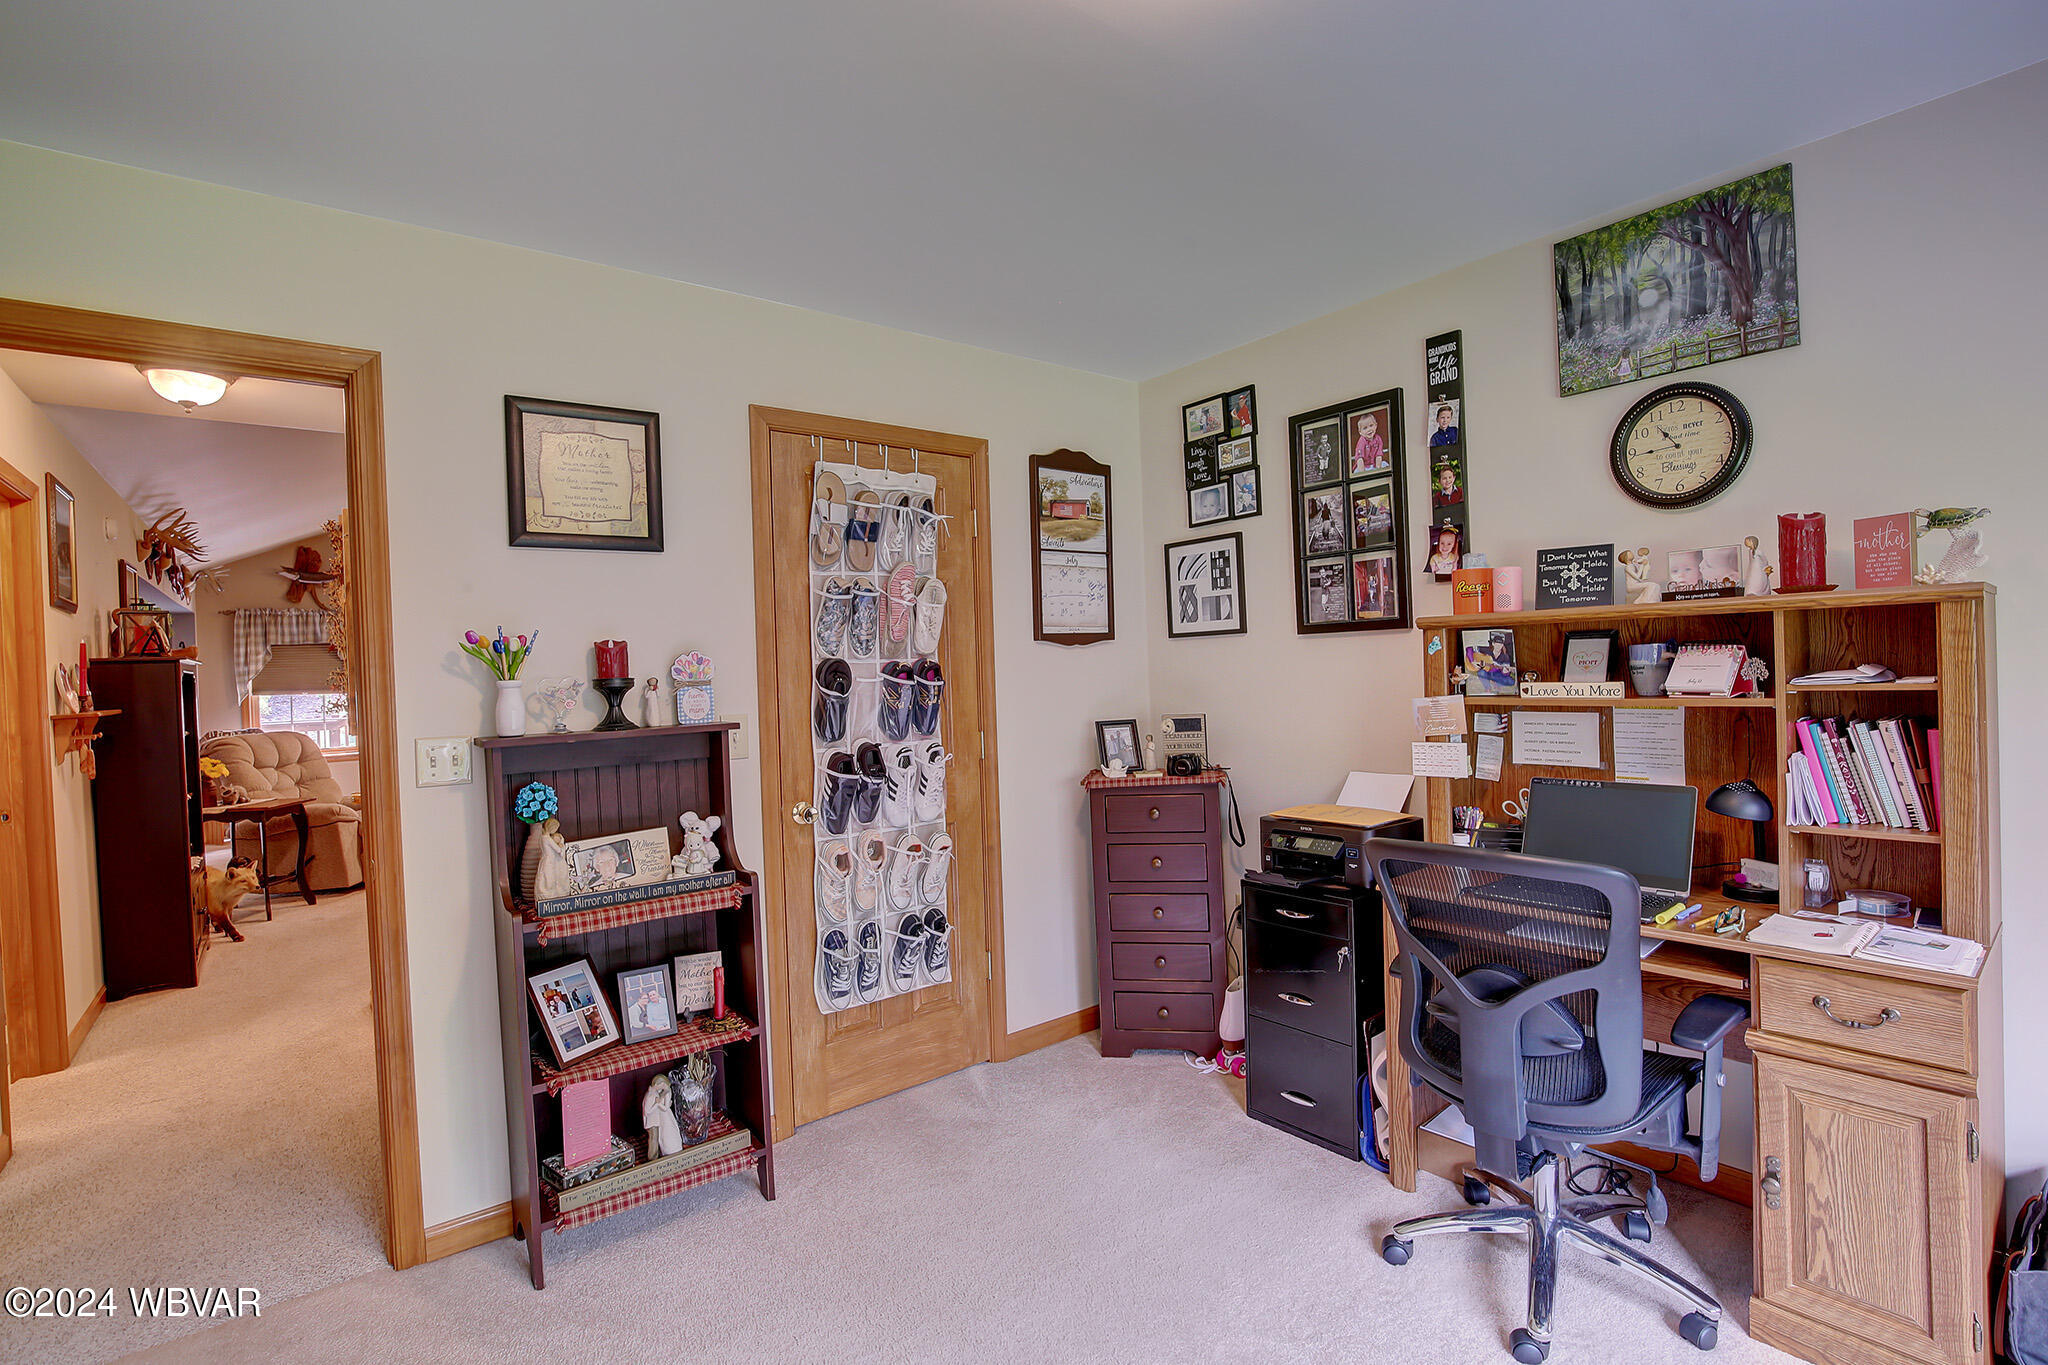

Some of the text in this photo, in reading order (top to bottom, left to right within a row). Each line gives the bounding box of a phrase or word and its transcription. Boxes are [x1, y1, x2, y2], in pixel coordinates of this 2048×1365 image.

[1428, 342, 1457, 358] GRANDKIDS
[1428, 356, 1439, 364] MAKE
[1430, 354, 1458, 371] life
[1430, 366, 1458, 386] GRAND
[1668, 400, 1685, 414] 12
[1698, 401, 1704, 413] 1
[1649, 411, 1663, 423] 11
[1714, 412, 1724, 424] 2
[1683, 420, 1704, 430] never
[1634, 428, 1649, 440] 10
[1684, 430, 1700, 438] time
[1723, 432, 1731, 445] 3
[558, 442, 609, 458] Mother
[1191, 447, 1203, 456] Live
[1628, 448, 1637, 461] 9
[1188, 458, 1205, 469] Laugh
[1716, 453, 1724, 466] 4
[1636, 467, 1645, 478] 8
[1662, 460, 1697, 474] Blessings
[1070, 474, 1103, 488] Adventure
[1194, 472, 1207, 480] Love
[1698, 471, 1707, 484] 5
[1655, 478, 1663, 490] 7
[1676, 478, 1685, 492] 6
[1854, 520, 1910, 550] mother
[1065, 555, 1078, 567] July
[1542, 554, 1545, 562] I
[1567, 552, 1587, 560] Know
[1588, 550, 1608, 558] What
[1539, 560, 1609, 573] Tomorrow Holds,
[1456, 580, 1490, 593] Reese's
[1542, 576, 1609, 587] But I Know
[1550, 584, 1605, 595] Who Holds
[1560, 596, 1599, 604] Tomorrow.
[1530, 685, 1621, 697] Love You More
[543, 874, 733, 915] Mirror, Mirror on the wall, I am my mother after all
[680, 967, 712, 980] Mothe
[640, 1168, 653, 1176] not
[656, 1159, 680, 1172] finding
[600, 1185, 625, 1198] finding
